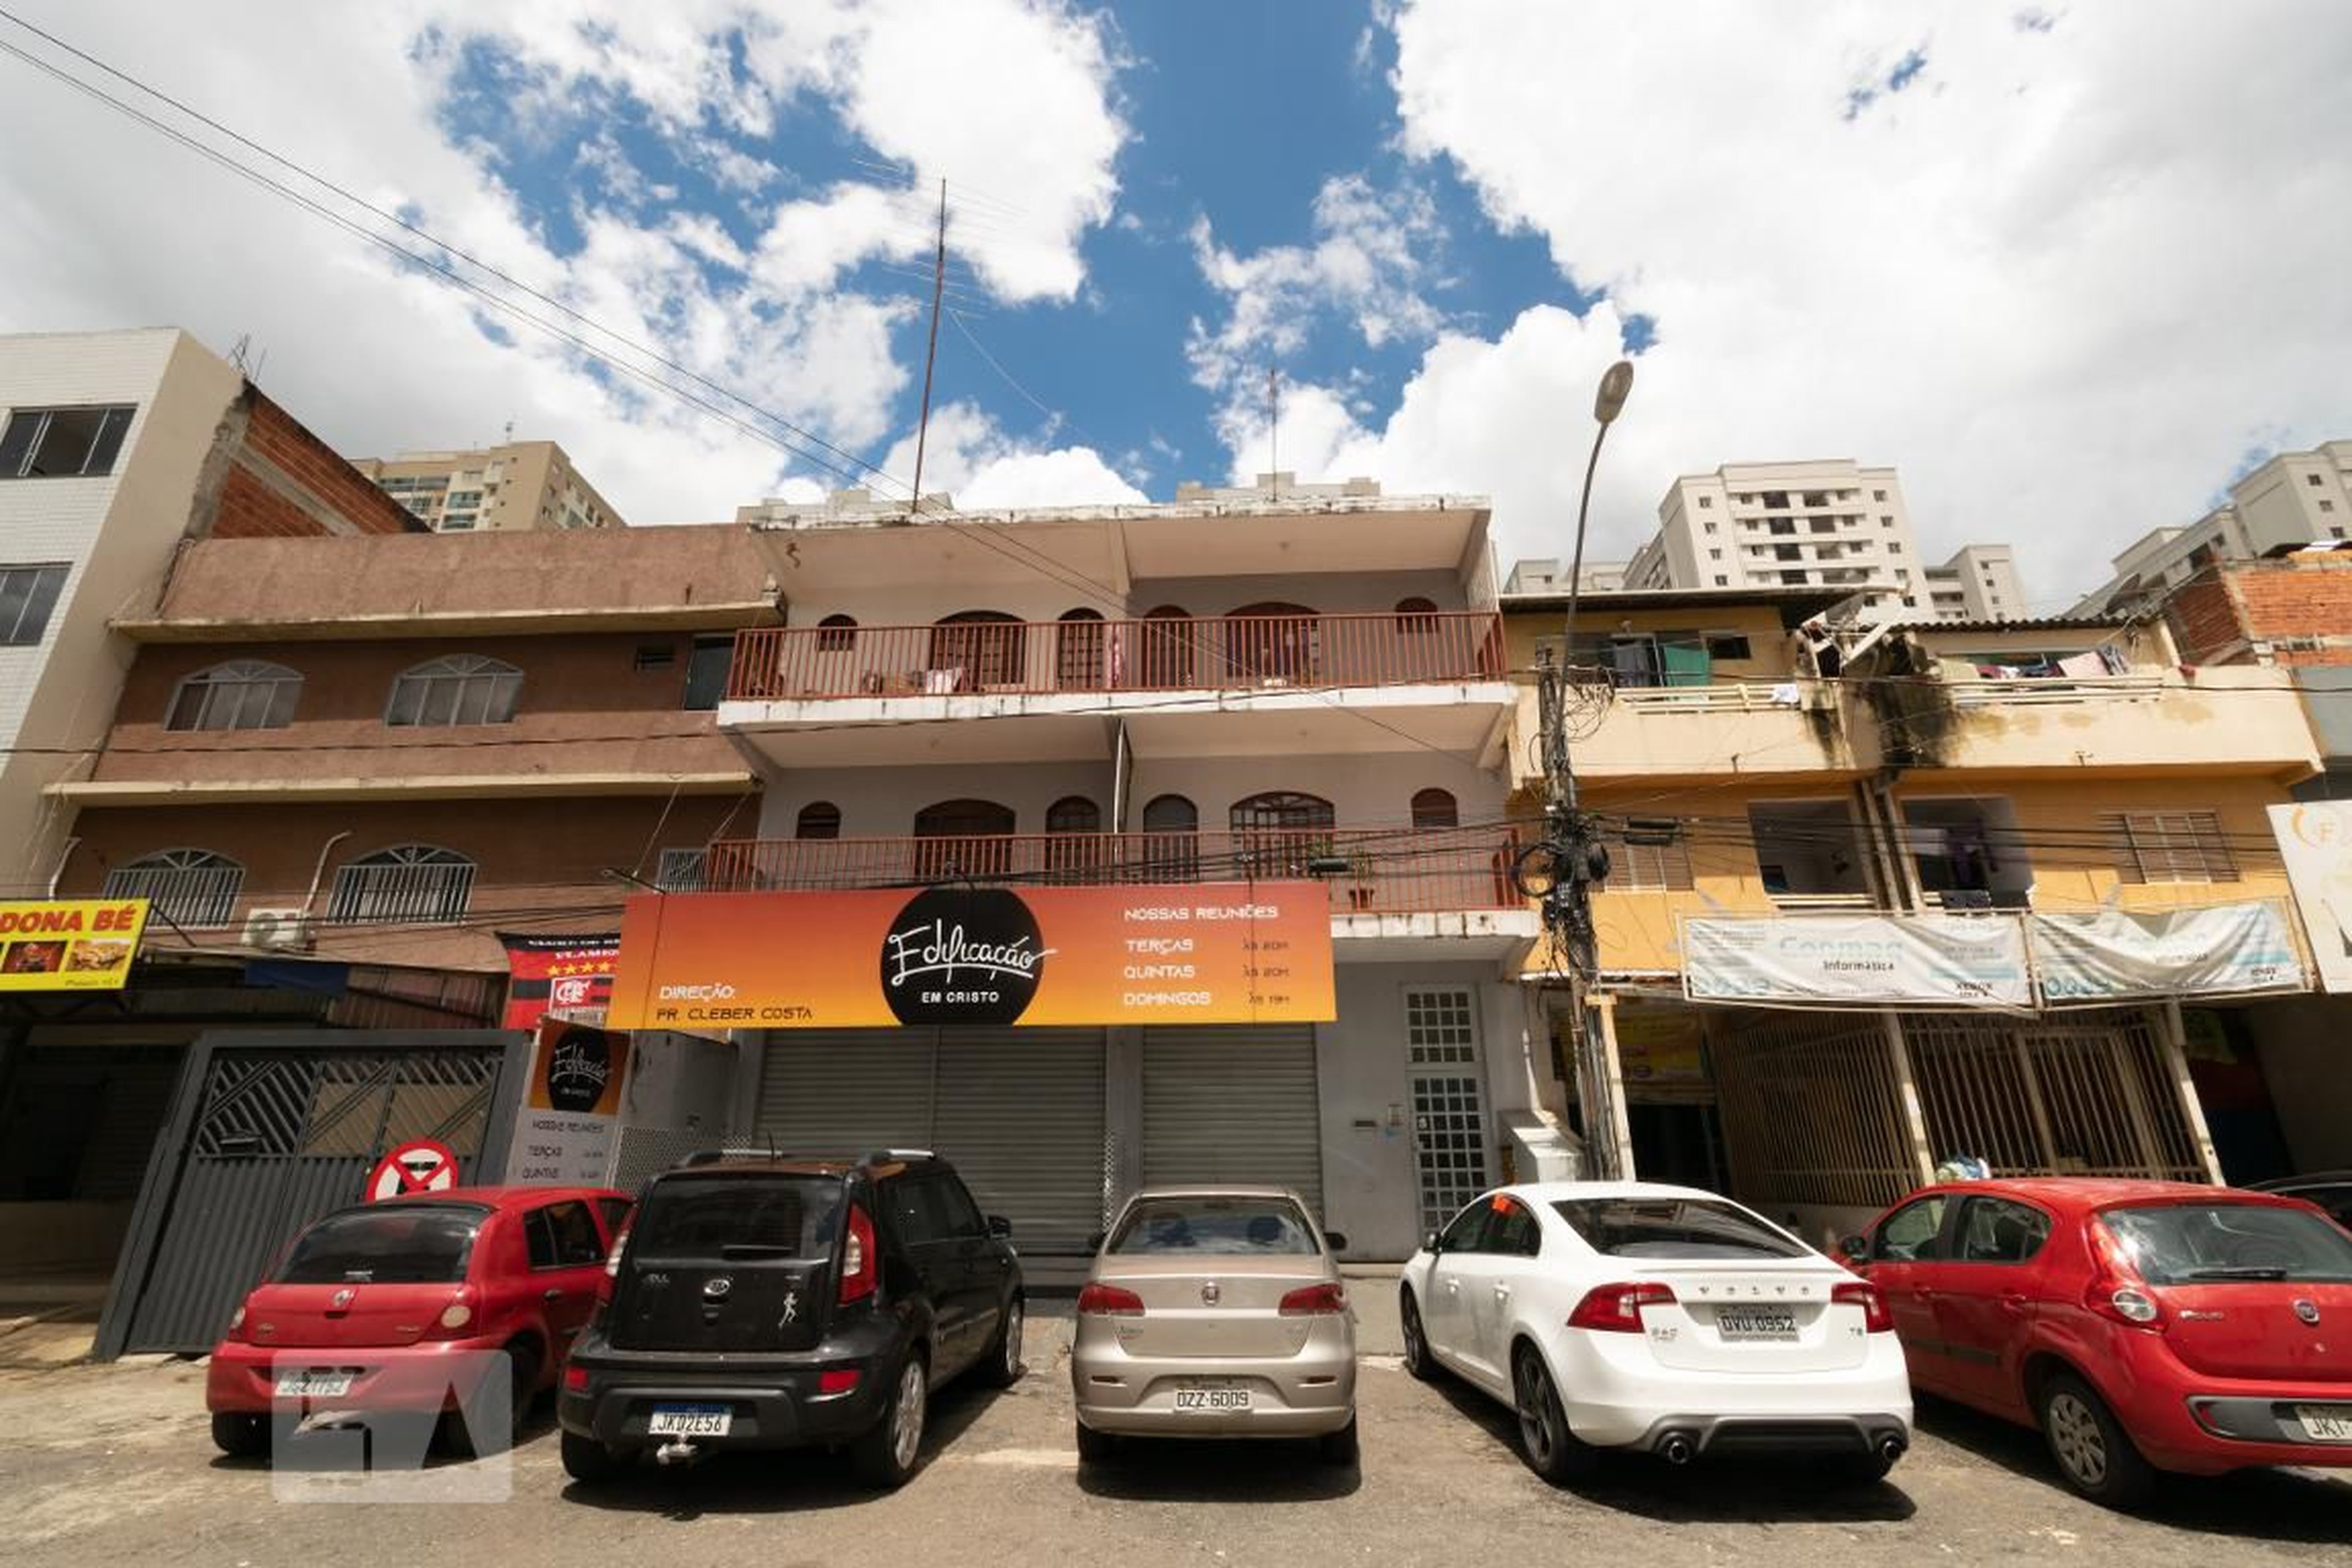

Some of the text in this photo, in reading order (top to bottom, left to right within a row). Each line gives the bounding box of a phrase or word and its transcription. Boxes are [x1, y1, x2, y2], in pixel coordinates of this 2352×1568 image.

[0, 903, 137, 933] DONA BÉ
[1125, 904, 1279, 920] NOSSAS REUNIÕES
[888, 918, 1058, 987] Edificação
[1126, 938, 1194, 954] TERÇAS
[1125, 965, 1196, 979] QUINTAS
[922, 992, 1000, 1003] EM CRISTO
[1125, 992, 1212, 1005] DOMINGOS
[687, 1008, 755, 1020] CLEBER
[761, 1006, 813, 1020] COSTA
